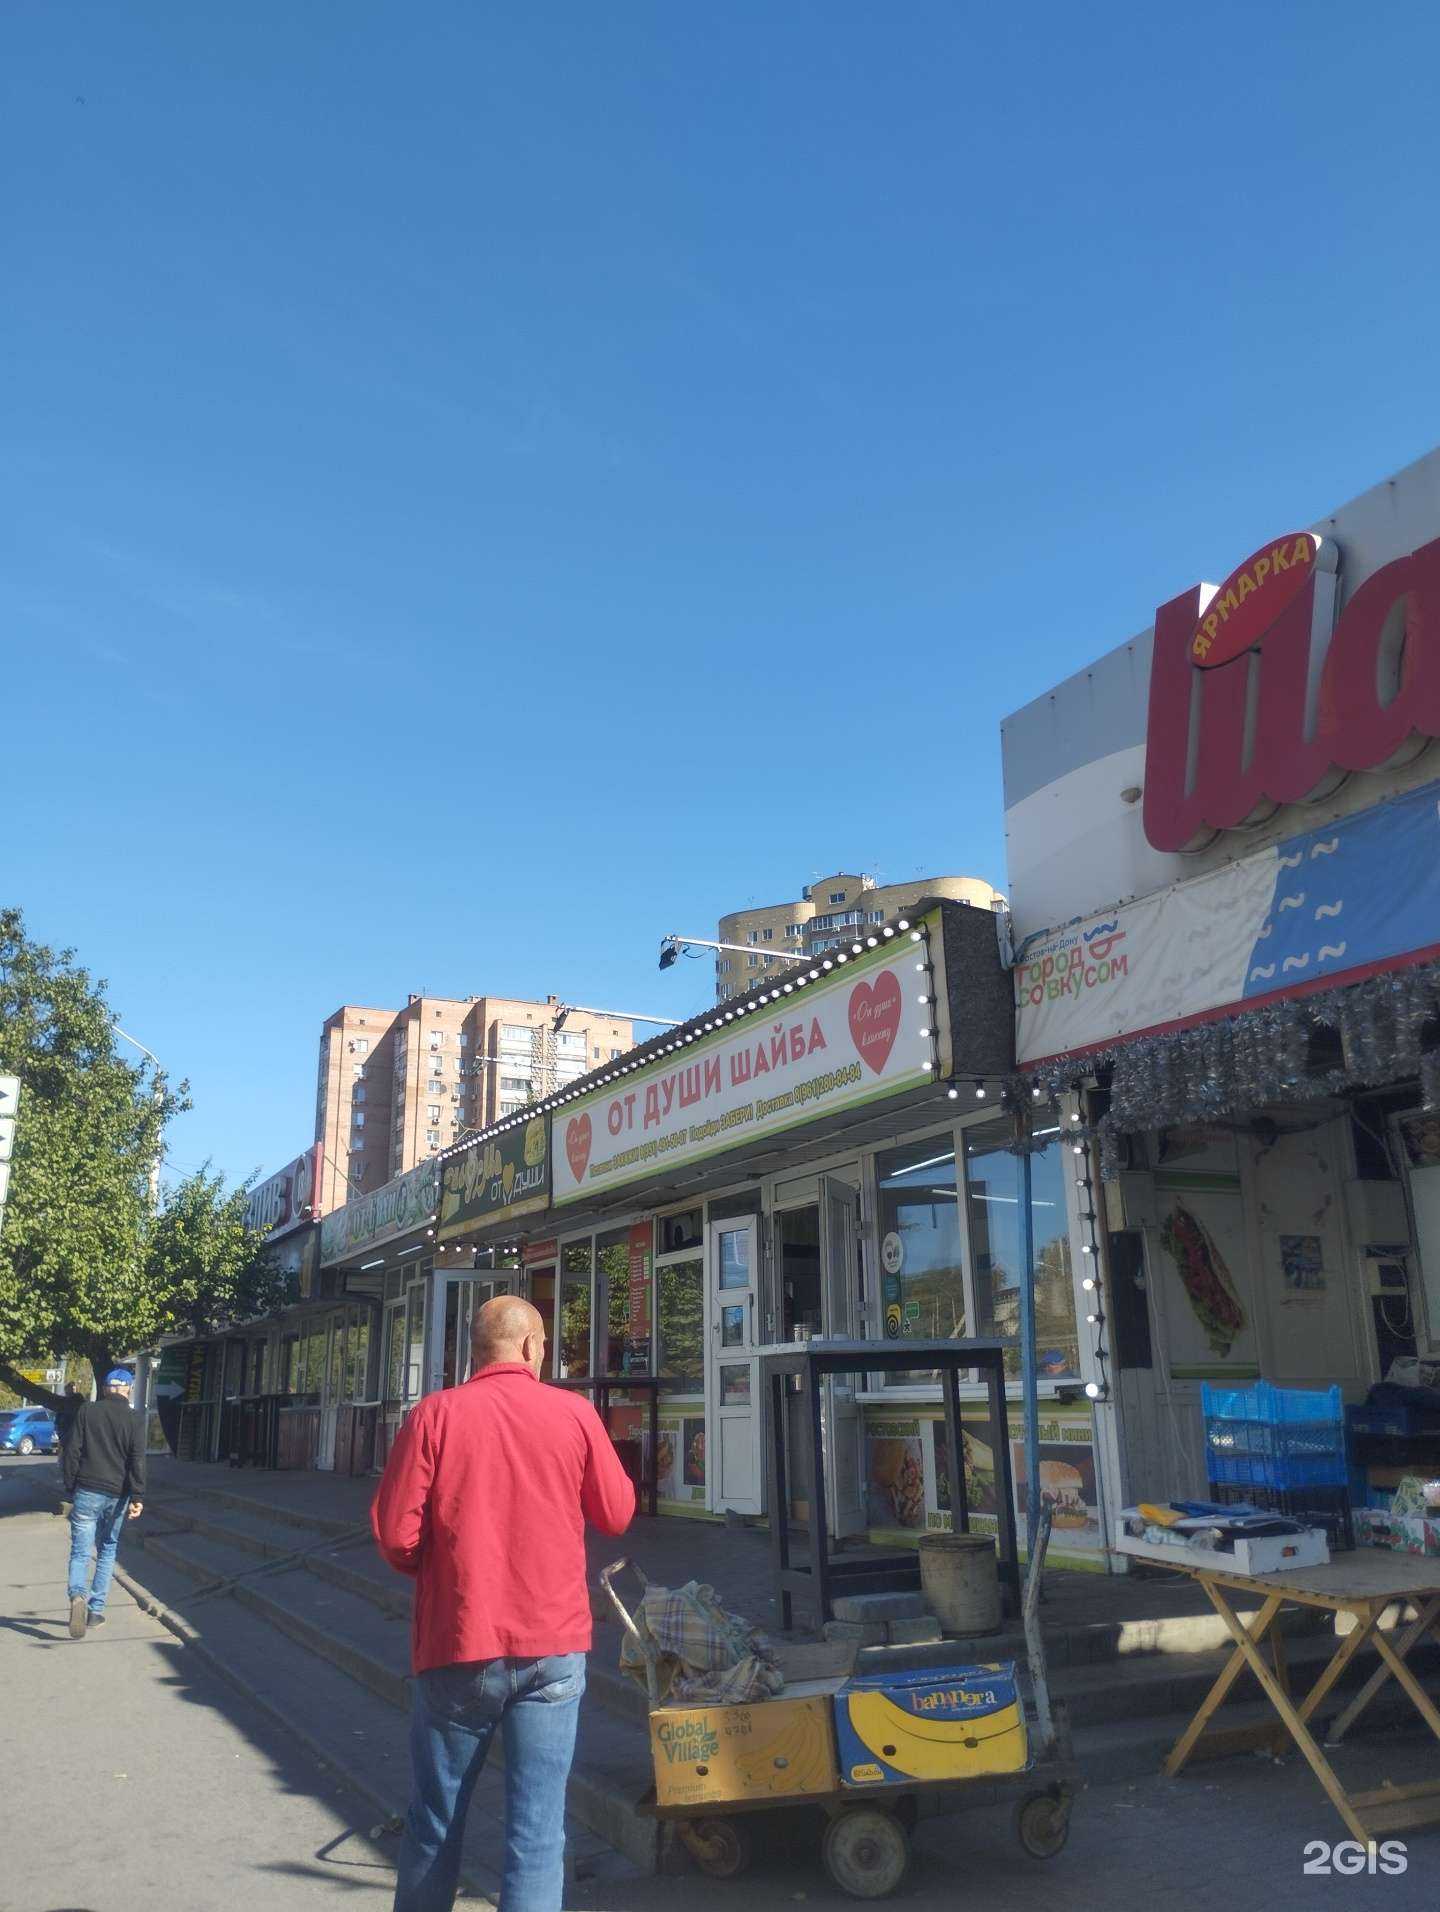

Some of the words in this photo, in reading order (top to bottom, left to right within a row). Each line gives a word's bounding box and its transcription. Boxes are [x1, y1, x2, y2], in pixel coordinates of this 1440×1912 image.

[1192, 536, 1310, 658] ЯРМАРКА
[607, 1093, 636, 1136] ОТ
[643, 1054, 721, 1131] ДУШИ
[730, 1016, 828, 1087] ШАЙБА
[657, 1716, 709, 1743] Global
[662, 1741, 720, 1763] Village
